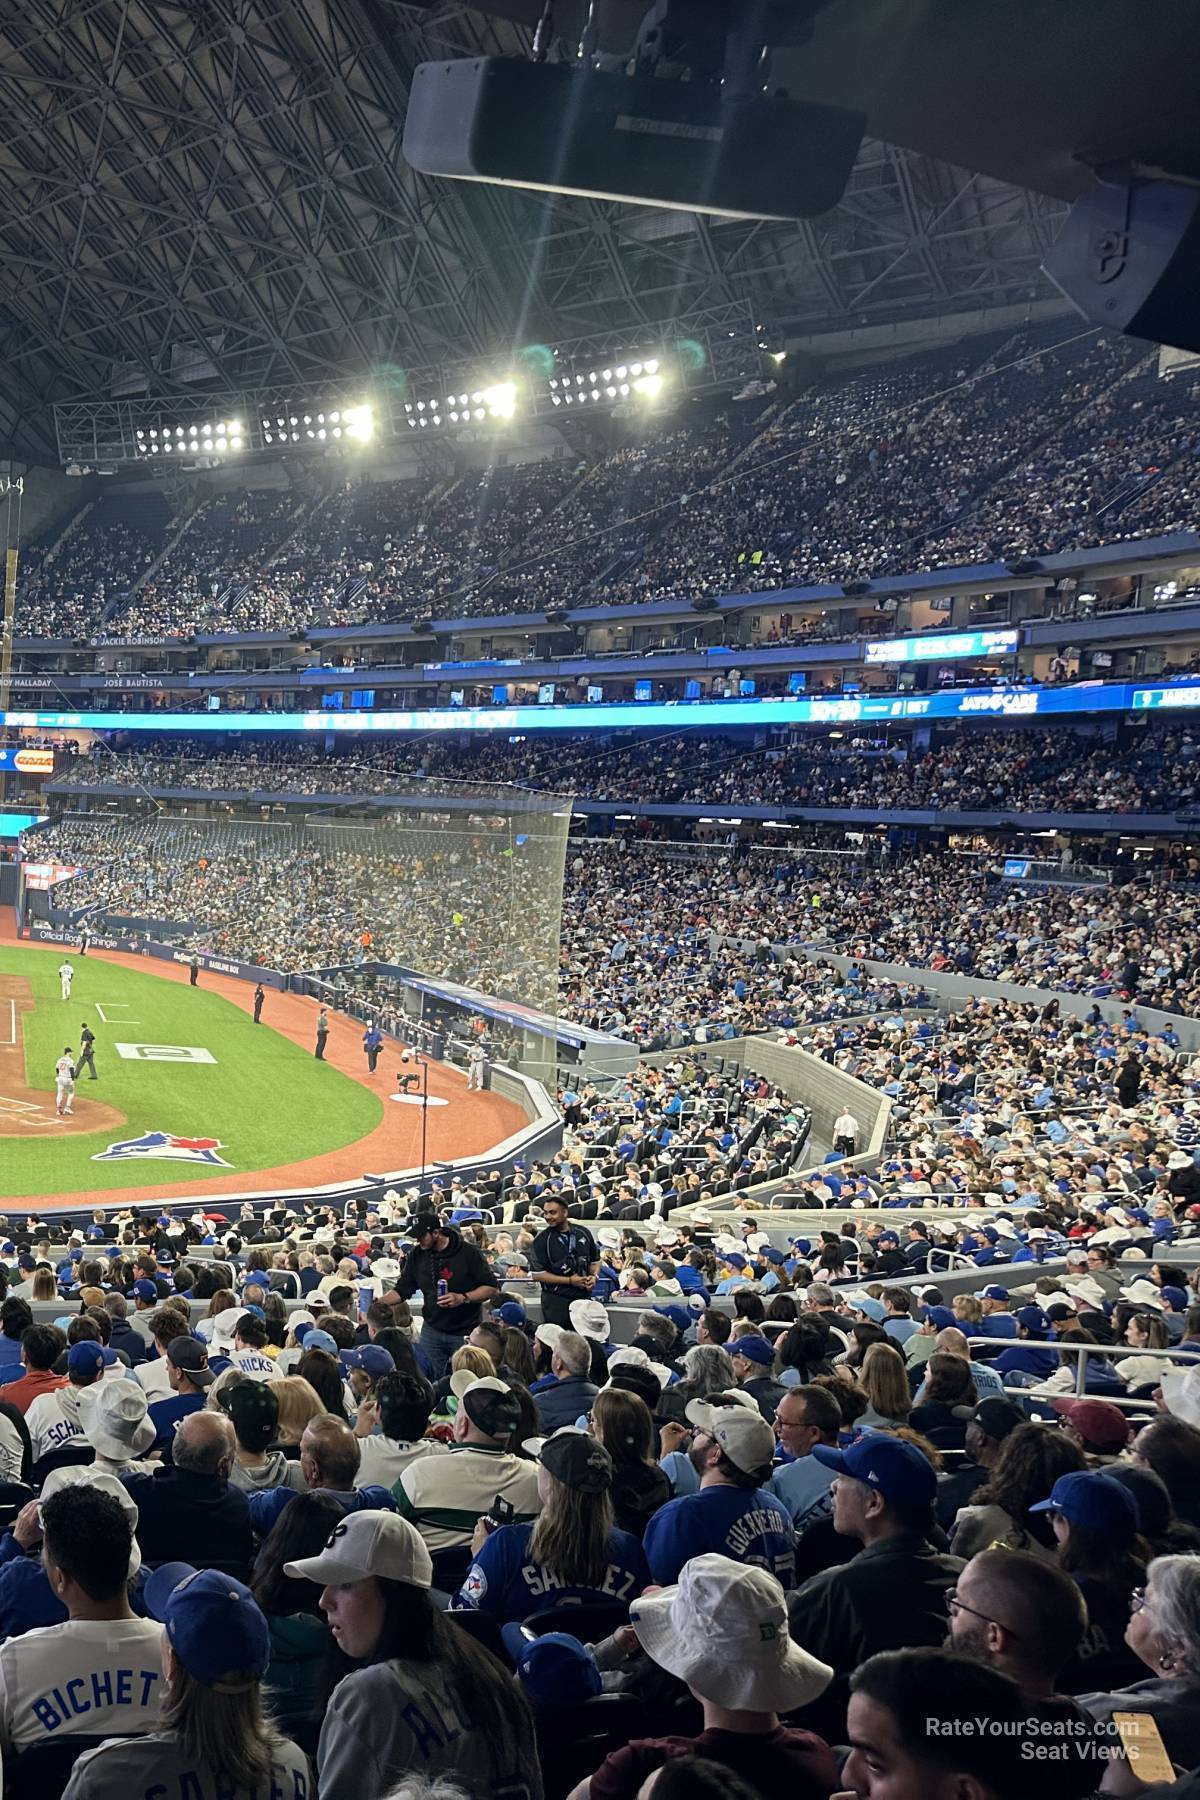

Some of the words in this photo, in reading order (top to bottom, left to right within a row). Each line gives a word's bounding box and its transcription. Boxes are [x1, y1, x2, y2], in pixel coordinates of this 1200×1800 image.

[101, 638, 127, 646] JACKIE
[128, 637, 166, 645] ROBINSON
[16, 679, 52, 687] HALLADAY
[126, 679, 163, 687] BAUTISTA
[40, 930, 64, 940] Official
[91, 936, 118, 949] Shingle
[239, 1358, 273, 1373] HICKS
[47, 1420, 84, 1444] SCH
[725, 1509, 784, 1555] GUERRERO
[32, 1669, 159, 1731] BICHET
